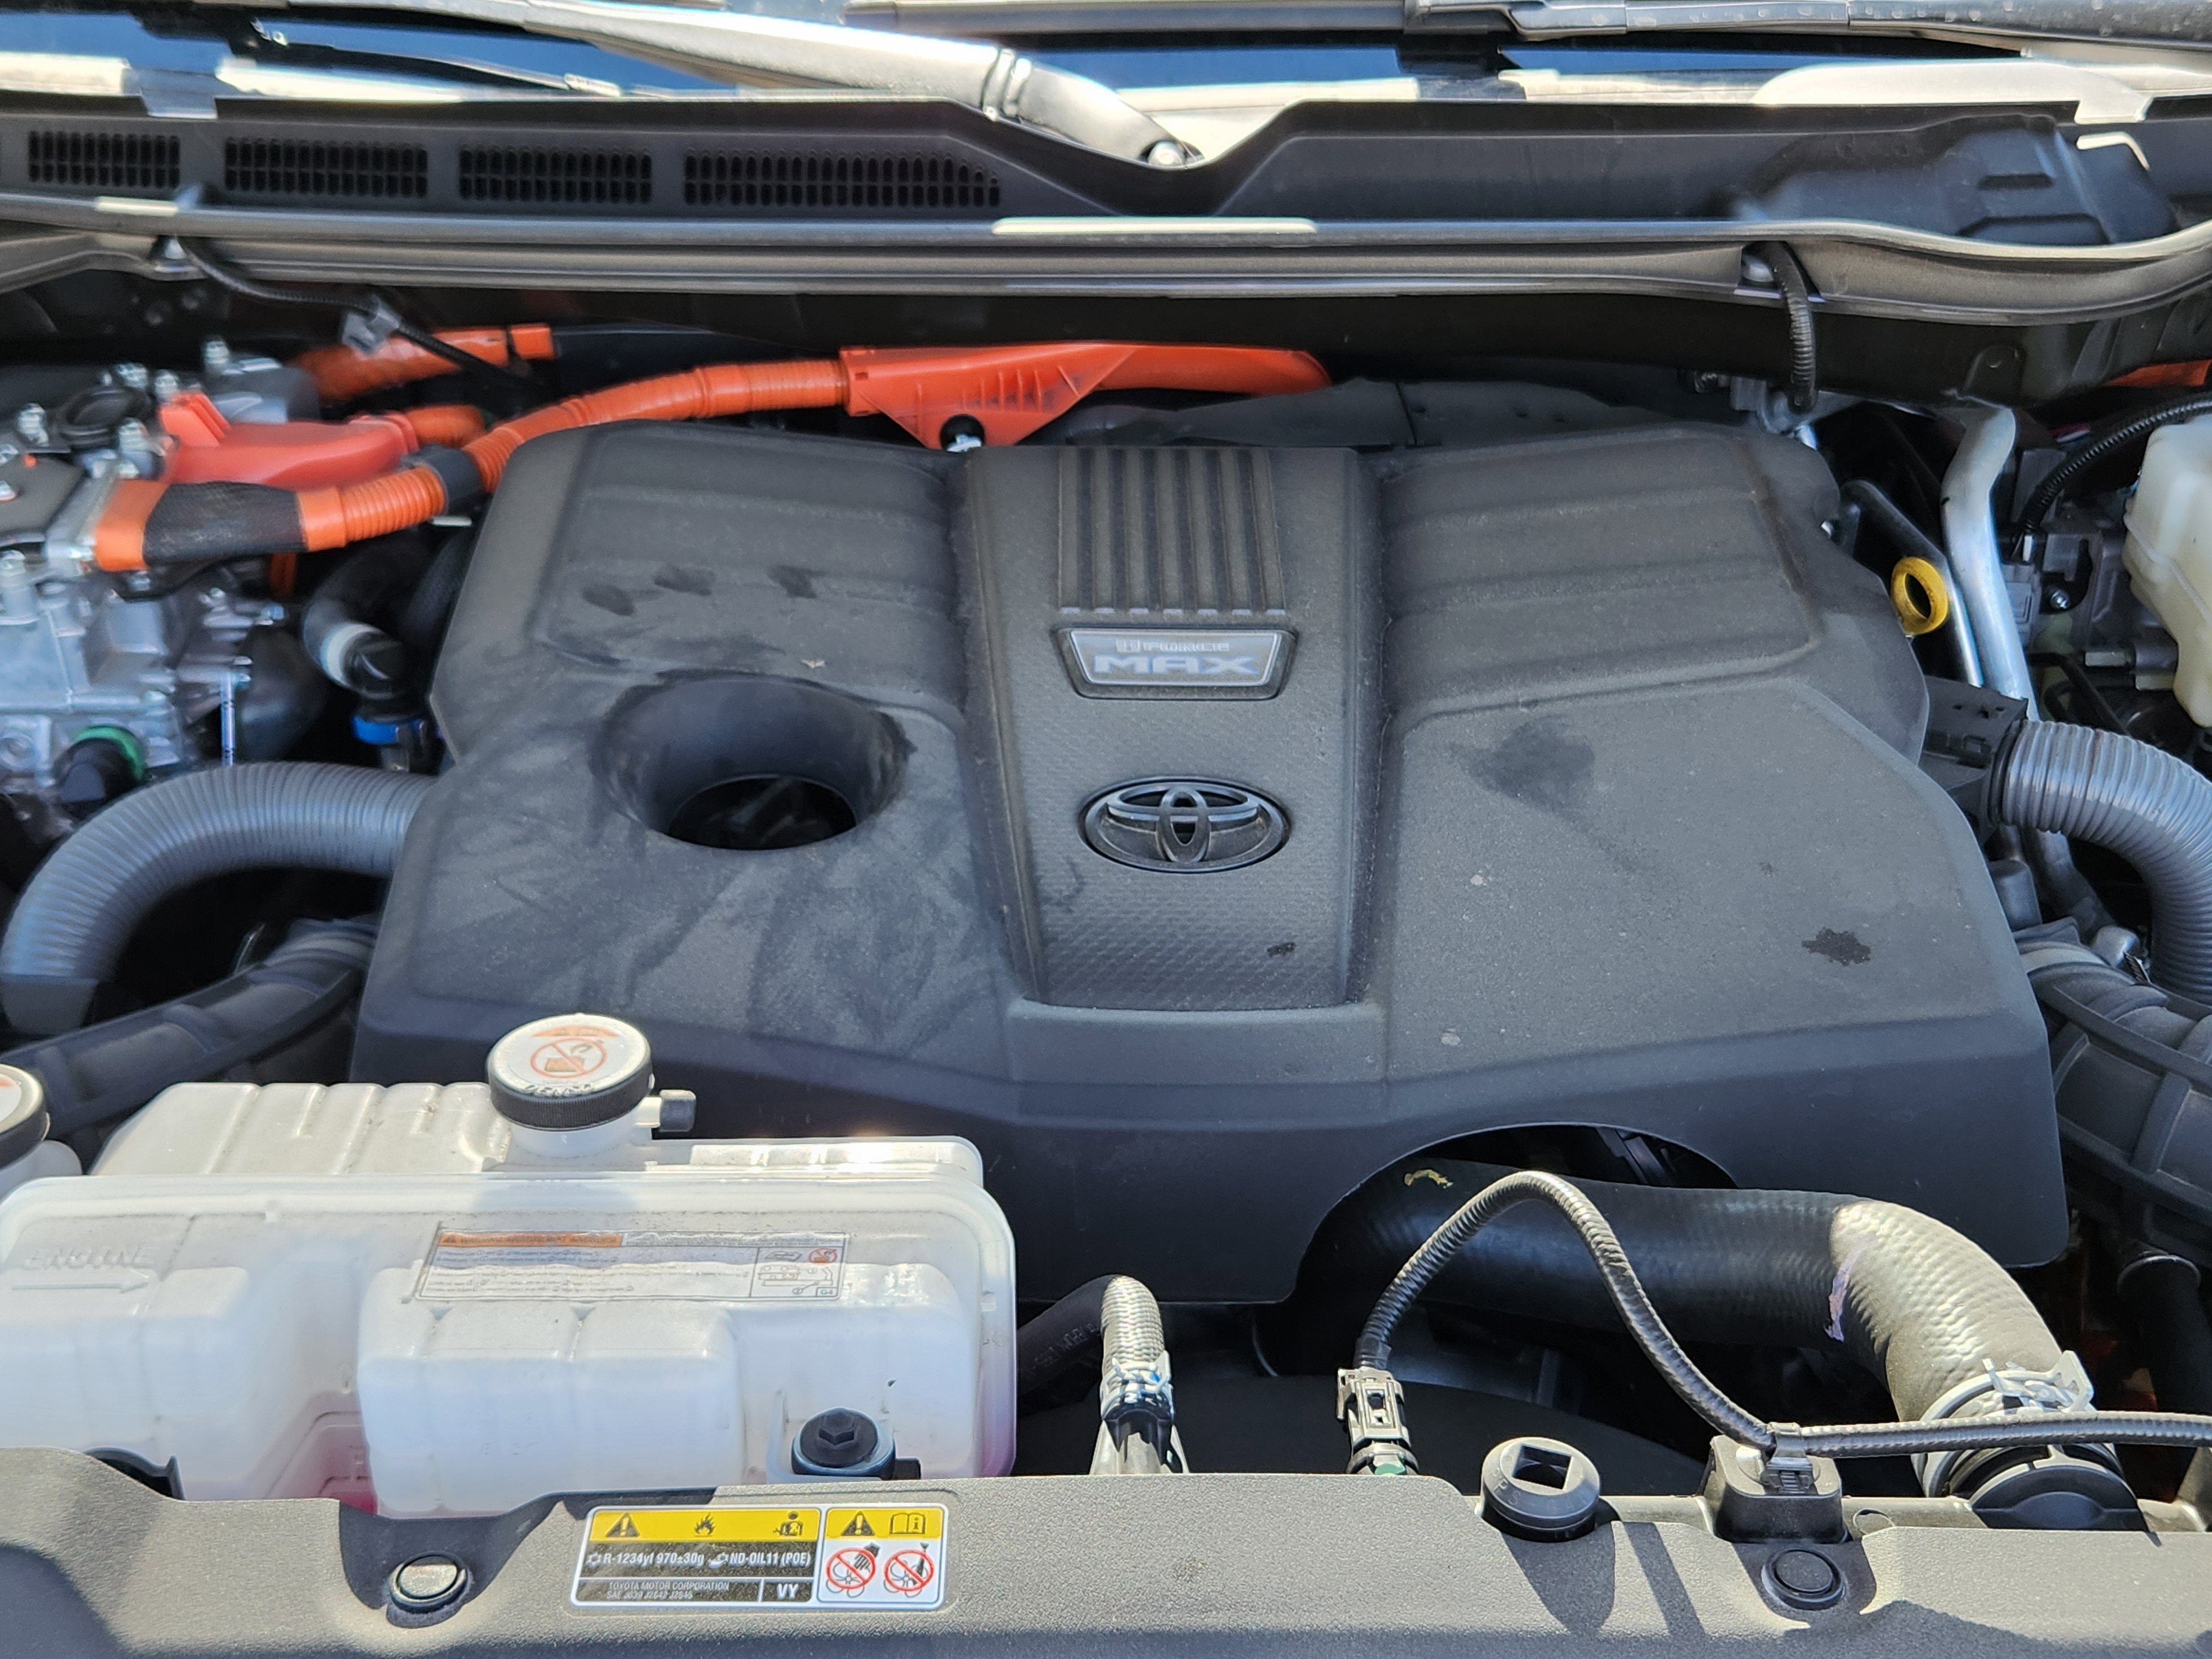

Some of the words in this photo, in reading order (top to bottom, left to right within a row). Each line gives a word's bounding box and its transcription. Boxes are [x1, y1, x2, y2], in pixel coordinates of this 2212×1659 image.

[1093, 654, 1261, 675] MAX
[22, 1244, 159, 1271] ENGINE
[656, 1552, 705, 1567] 970±30g
[729, 1552, 779, 1566] ND-OIL11
[781, 1552, 811, 1567] (POE)
[609, 1581, 639, 1590] TOYOTA
[641, 1581, 670, 1590] MOTOR
[672, 1582, 729, 1591] CORPORATION
[776, 1583, 799, 1599] VY
[607, 1590, 622, 1599] SAE
